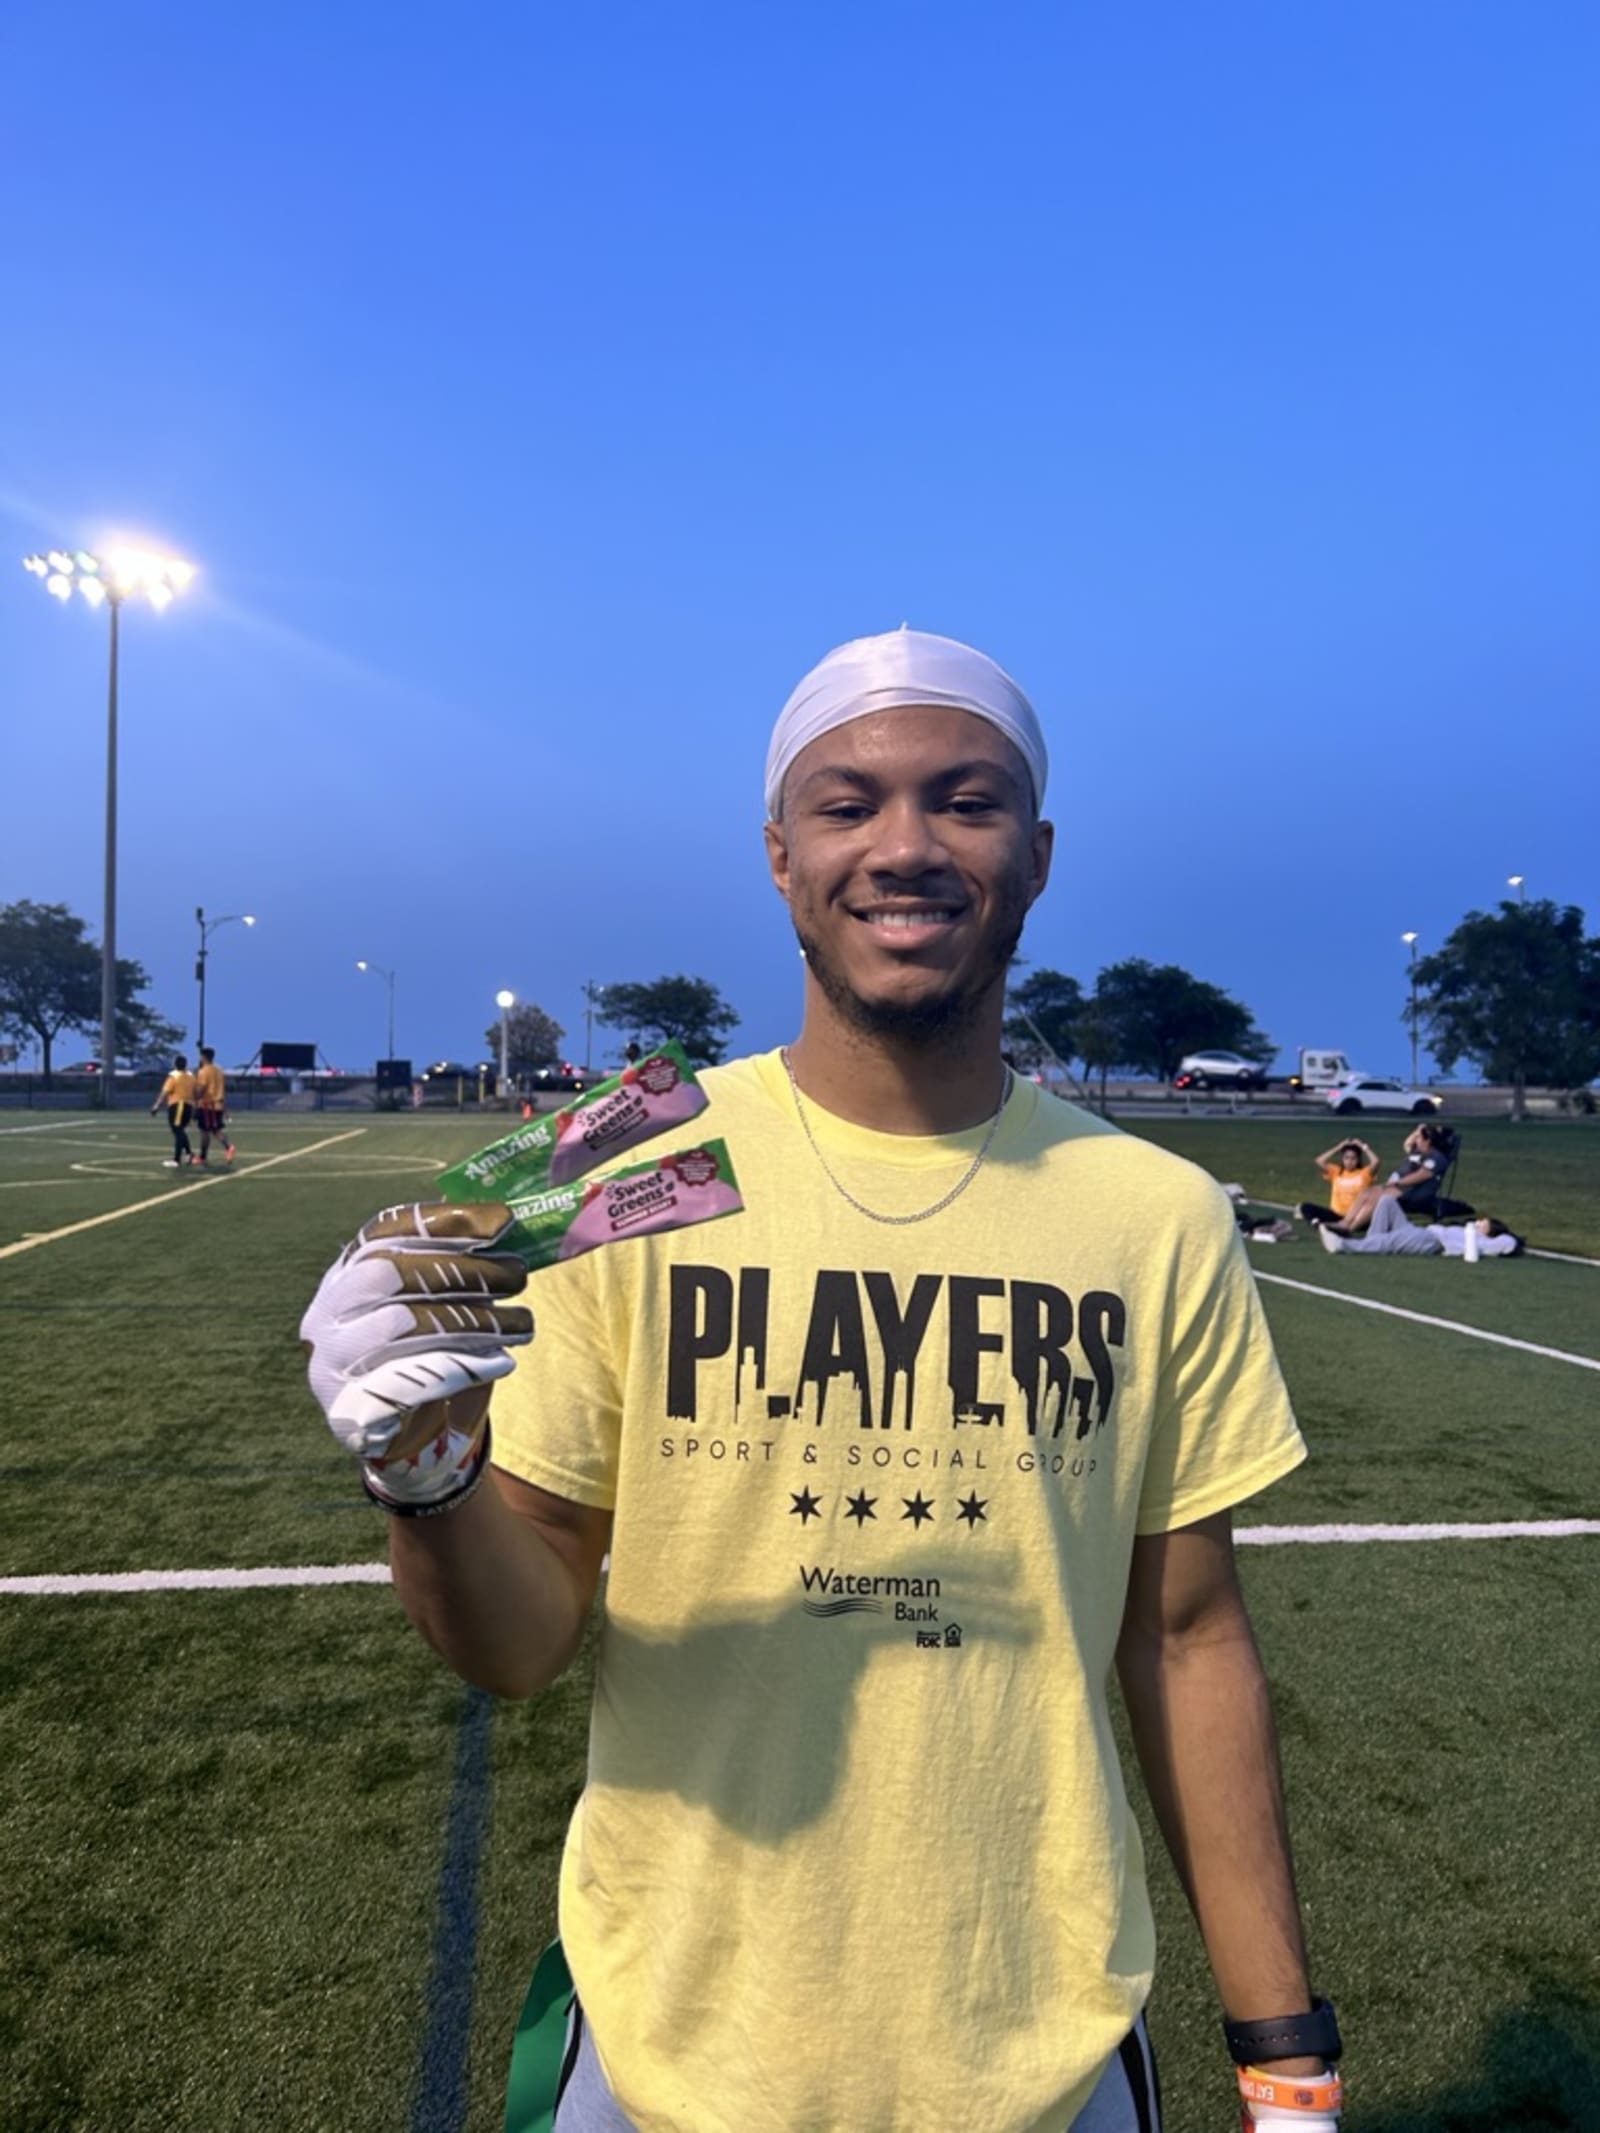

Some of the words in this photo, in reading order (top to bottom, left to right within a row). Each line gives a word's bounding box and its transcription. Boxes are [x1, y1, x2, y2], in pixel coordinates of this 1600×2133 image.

[583, 1104, 634, 1142] Greens
[586, 1089, 631, 1127] Sweet
[464, 1124, 552, 1180] Amazing
[607, 1187, 664, 1218] Greens
[614, 1171, 664, 1201] Sweet
[512, 1190, 577, 1219] azing
[666, 1263, 1126, 1440] PLAYERS
[660, 1438, 775, 1462] SPORT
[803, 1443, 818, 1464] &
[847, 1444, 987, 1470] SOCIAL
[1016, 1451, 1097, 1478] GROUP
[800, 1565, 941, 1597] Waterman
[894, 1602, 939, 1622] Bank
